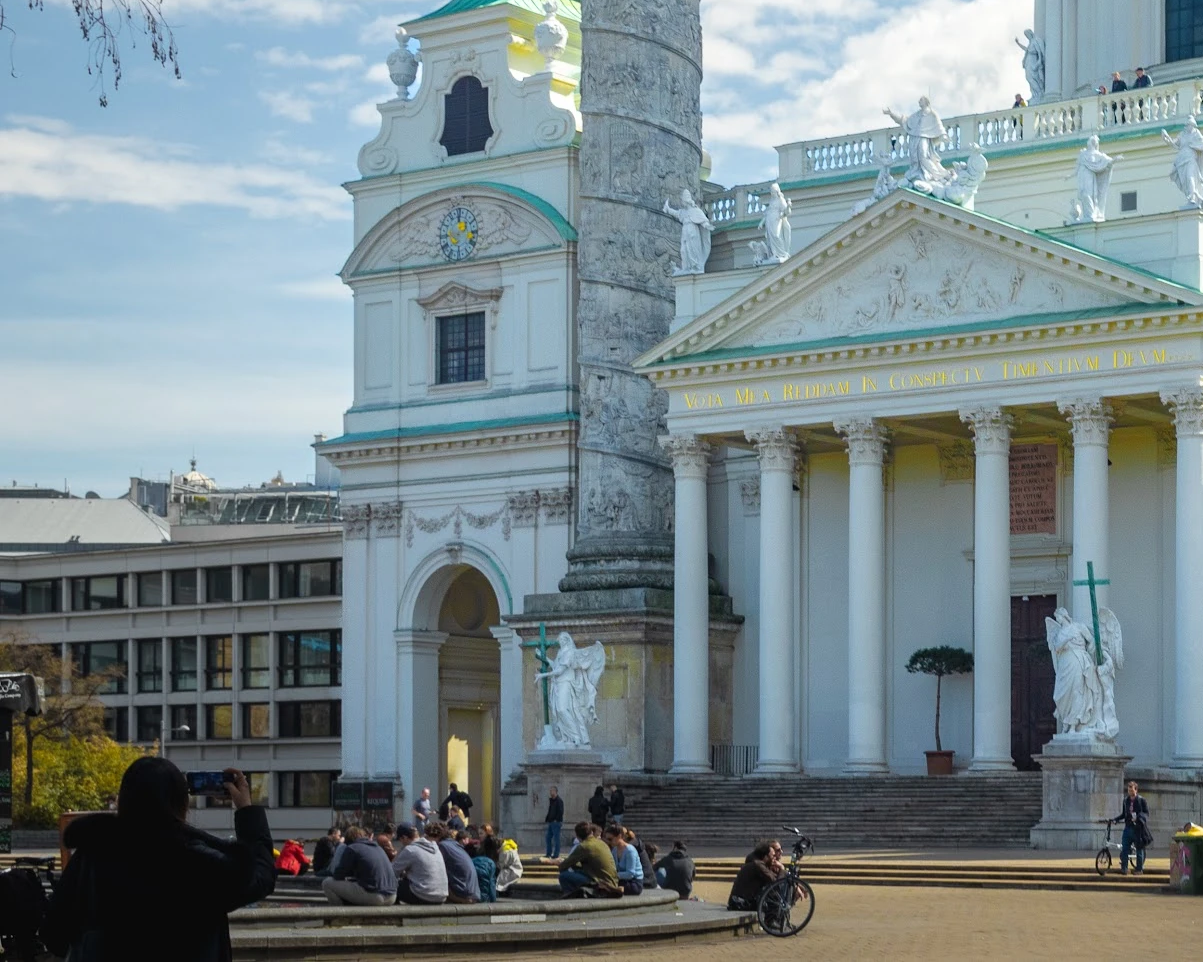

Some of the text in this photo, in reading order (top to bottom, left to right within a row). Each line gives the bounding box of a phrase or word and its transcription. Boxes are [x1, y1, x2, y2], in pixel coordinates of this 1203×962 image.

[683, 392, 724, 410] VOTA
[735, 387, 772, 405] MEA
[783, 381, 850, 401] REDDAM
[861, 375, 878, 394] IN
[889, 366, 985, 389] CONSPECTV
[1001, 356, 1100, 380] TIMENTIVM
[1113, 349, 1167, 369] DEVM
